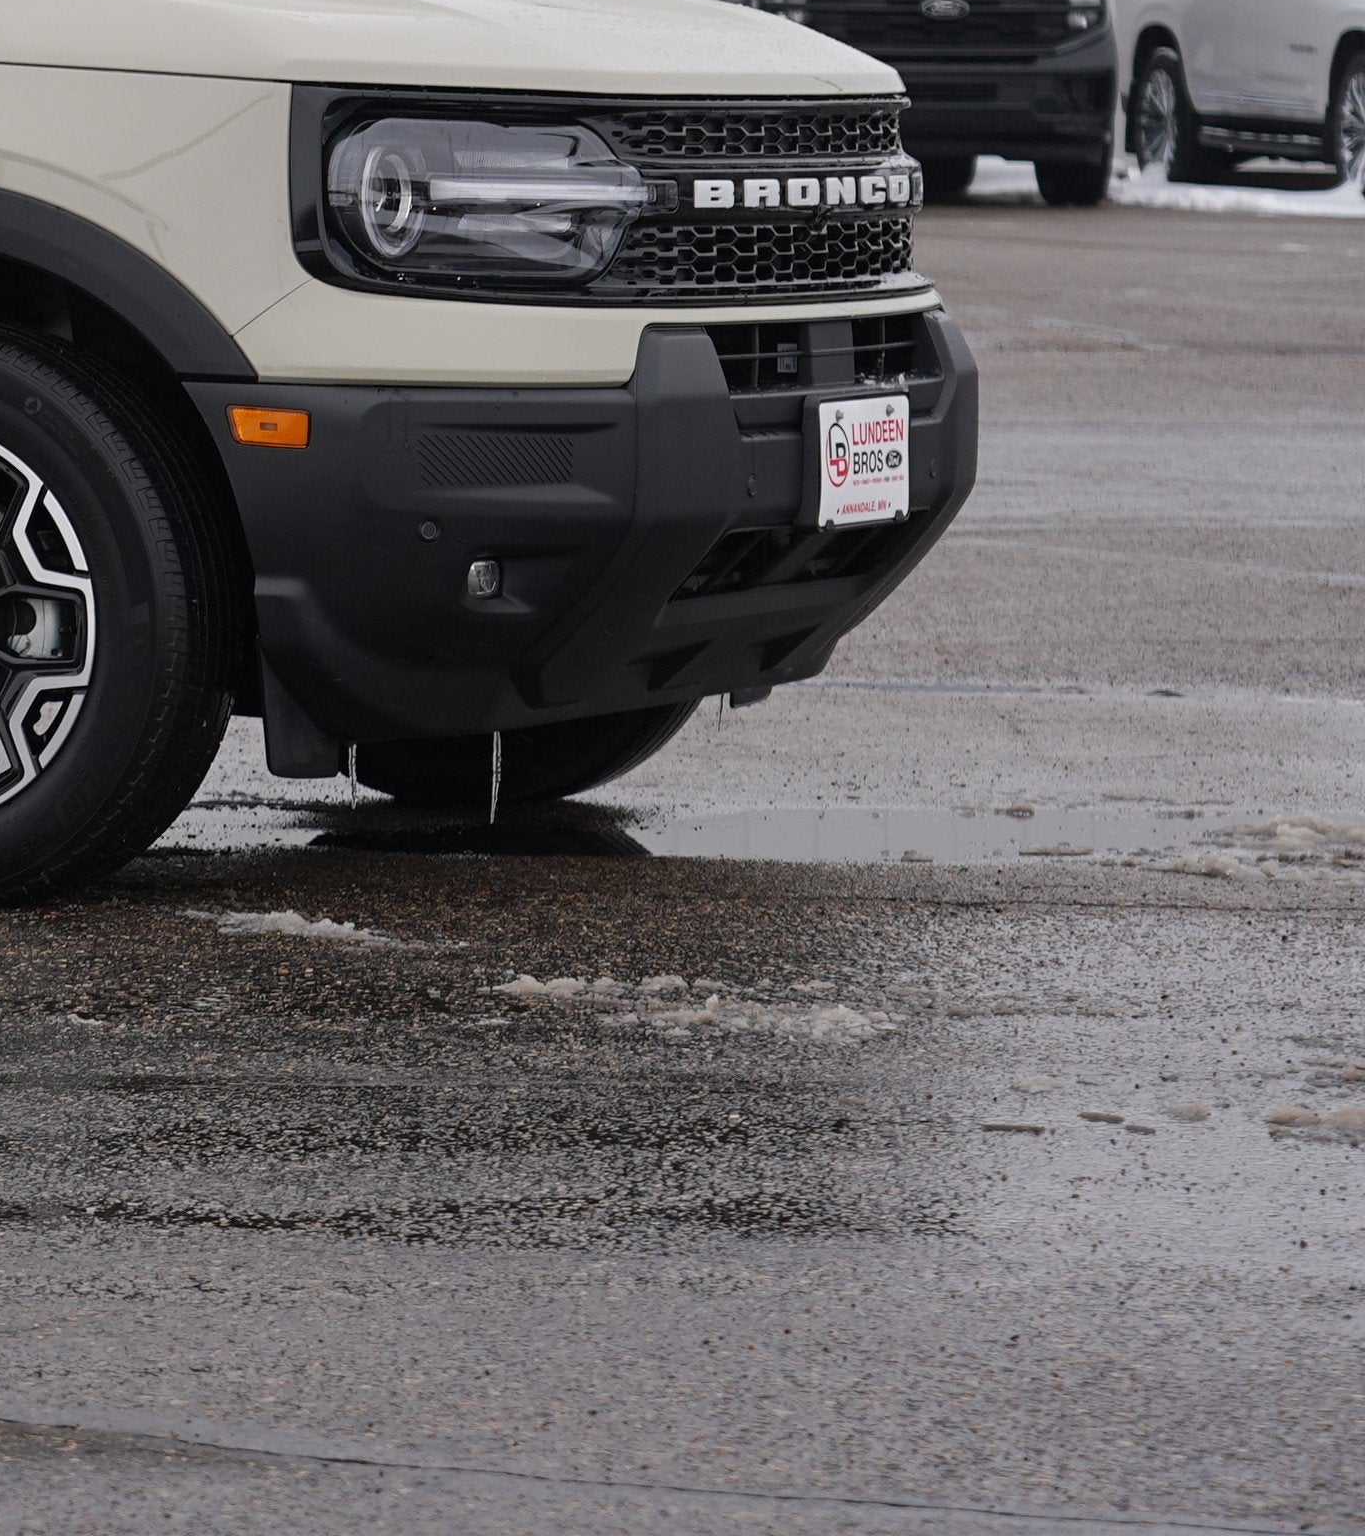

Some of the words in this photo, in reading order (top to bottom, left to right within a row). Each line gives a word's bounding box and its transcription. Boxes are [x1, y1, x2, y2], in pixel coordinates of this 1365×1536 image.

[693, 175, 910, 210] BRONCO
[852, 418, 904, 445] LUNDEEN
[853, 449, 884, 475] BROS
